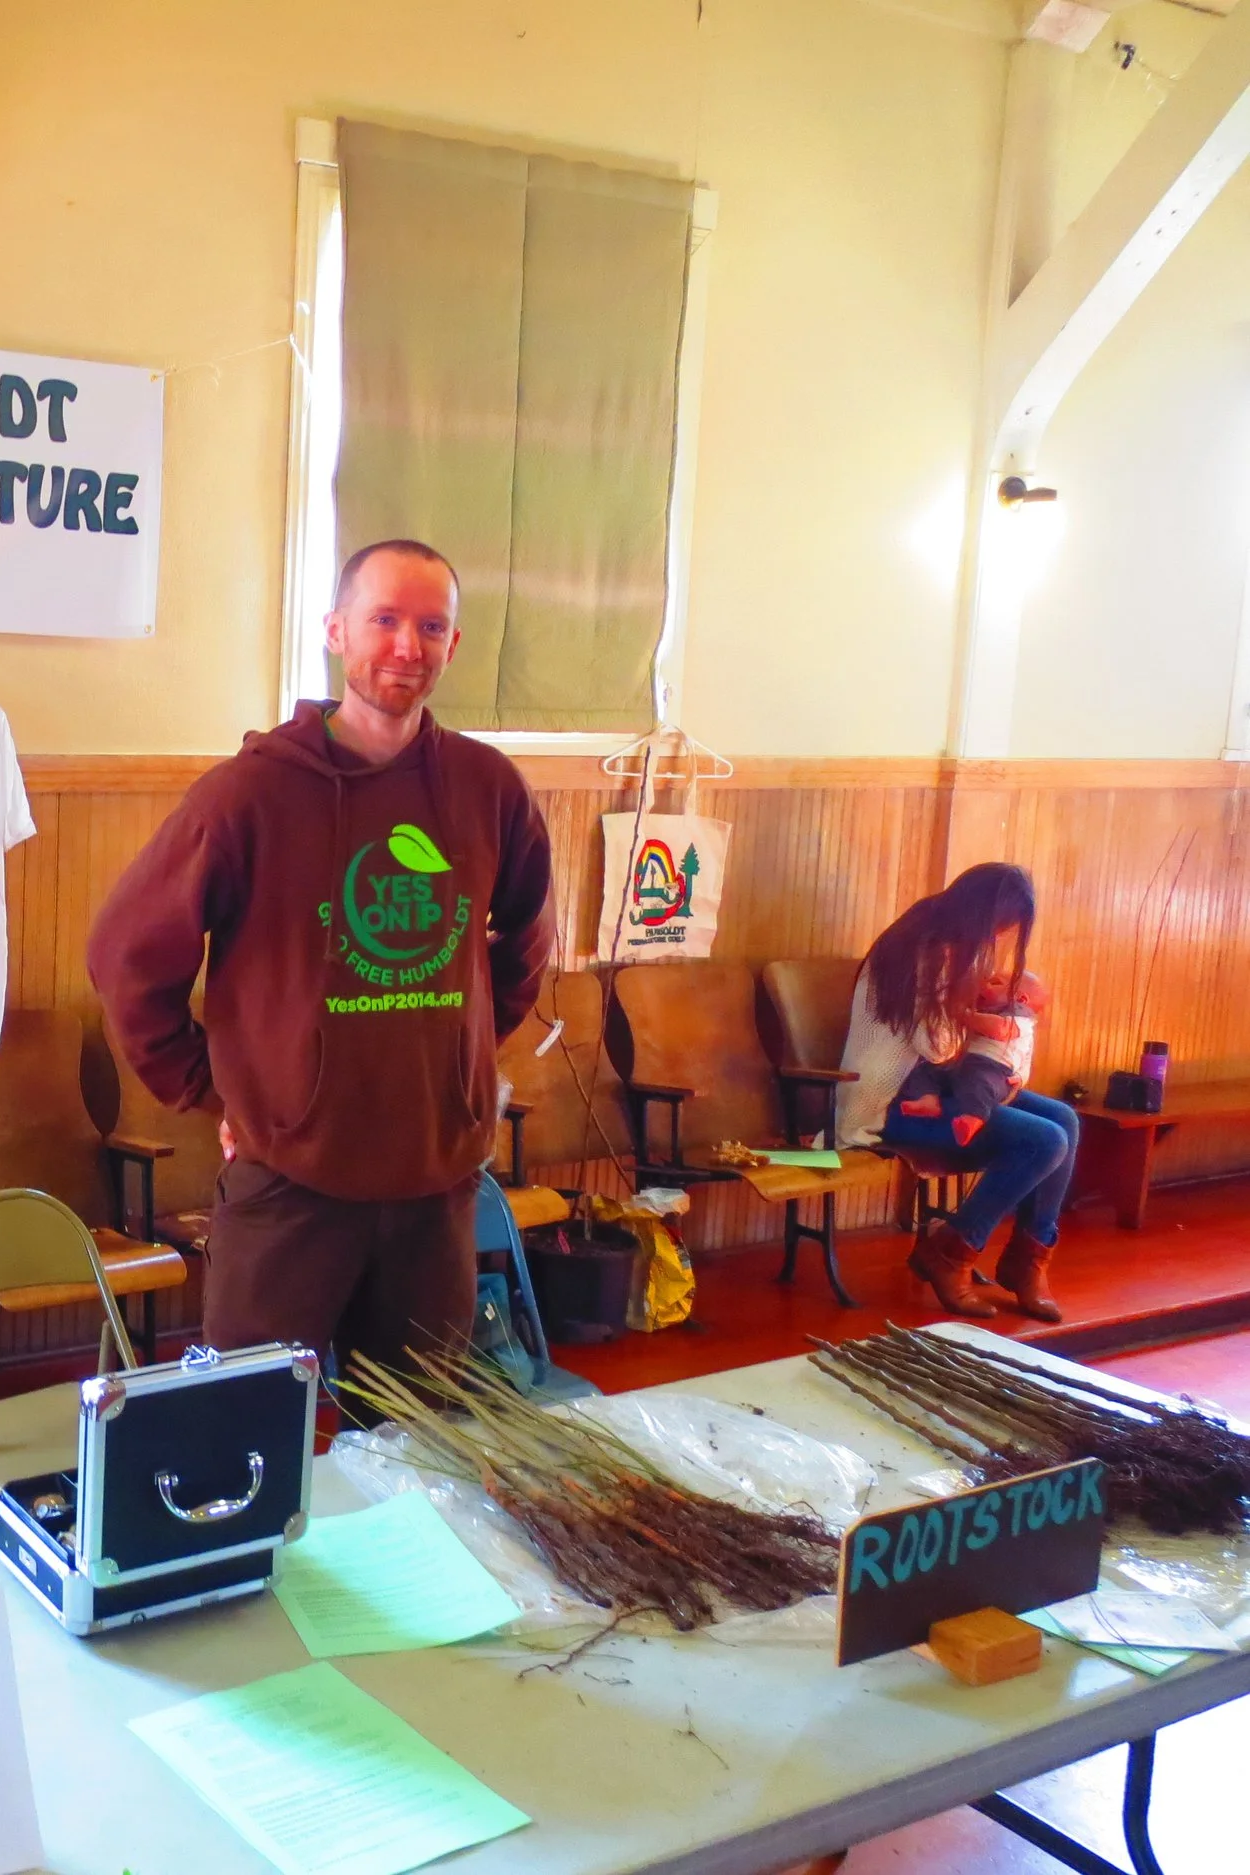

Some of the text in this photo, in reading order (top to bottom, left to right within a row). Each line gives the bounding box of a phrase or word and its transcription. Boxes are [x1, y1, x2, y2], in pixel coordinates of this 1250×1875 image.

[368, 874, 433, 903] YES
[361, 903, 410, 933] ON
[417, 903, 442, 931] P
[346, 951, 394, 986] FREE
[399, 894, 472, 986] HUMBOLDT
[326, 991, 463, 1014] YesOnP2014.org
[849, 1464, 1107, 1594] ROOTSTOCK
